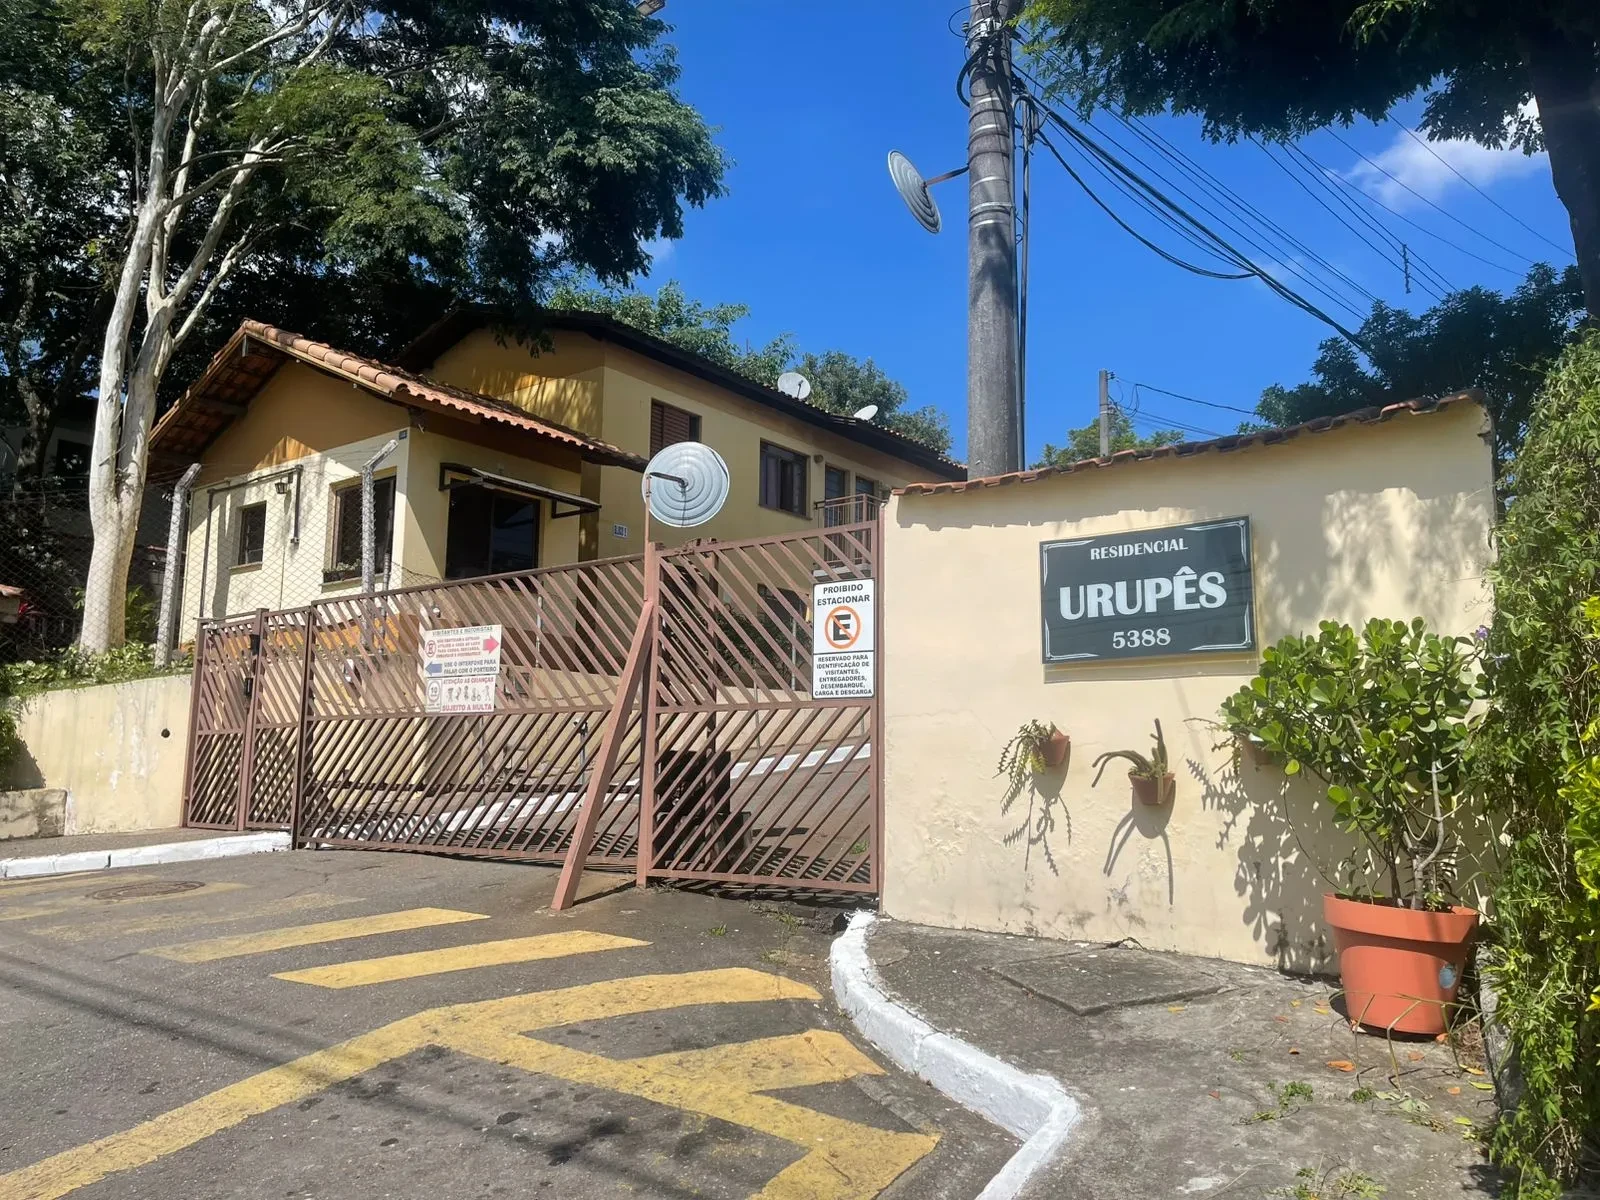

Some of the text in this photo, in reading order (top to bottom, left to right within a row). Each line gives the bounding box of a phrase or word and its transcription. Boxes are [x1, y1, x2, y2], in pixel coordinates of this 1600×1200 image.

[1090, 538, 1188, 560] RESIDENCIAL
[823, 584, 864, 594] PROIBIDO
[1059, 565, 1227, 620] URUPÊS
[817, 594, 870, 606] ESTACIONAR
[1112, 628, 1172, 648] 5388
